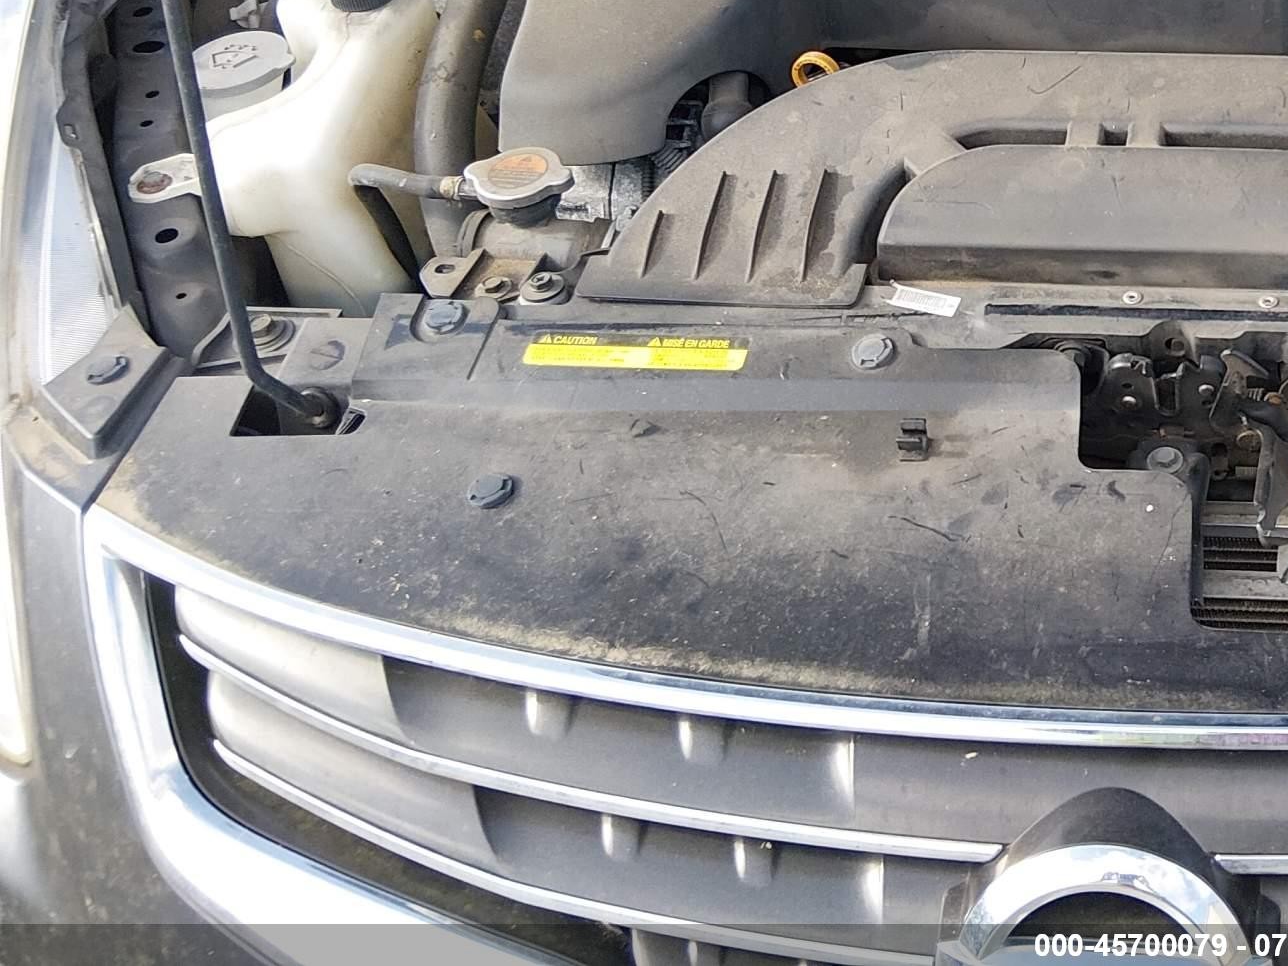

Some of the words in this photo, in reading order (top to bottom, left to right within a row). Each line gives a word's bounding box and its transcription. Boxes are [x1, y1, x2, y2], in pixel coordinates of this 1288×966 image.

[553, 335, 598, 345] CAUTION
[685, 339, 698, 348] EN
[698, 339, 731, 349] GARDE
